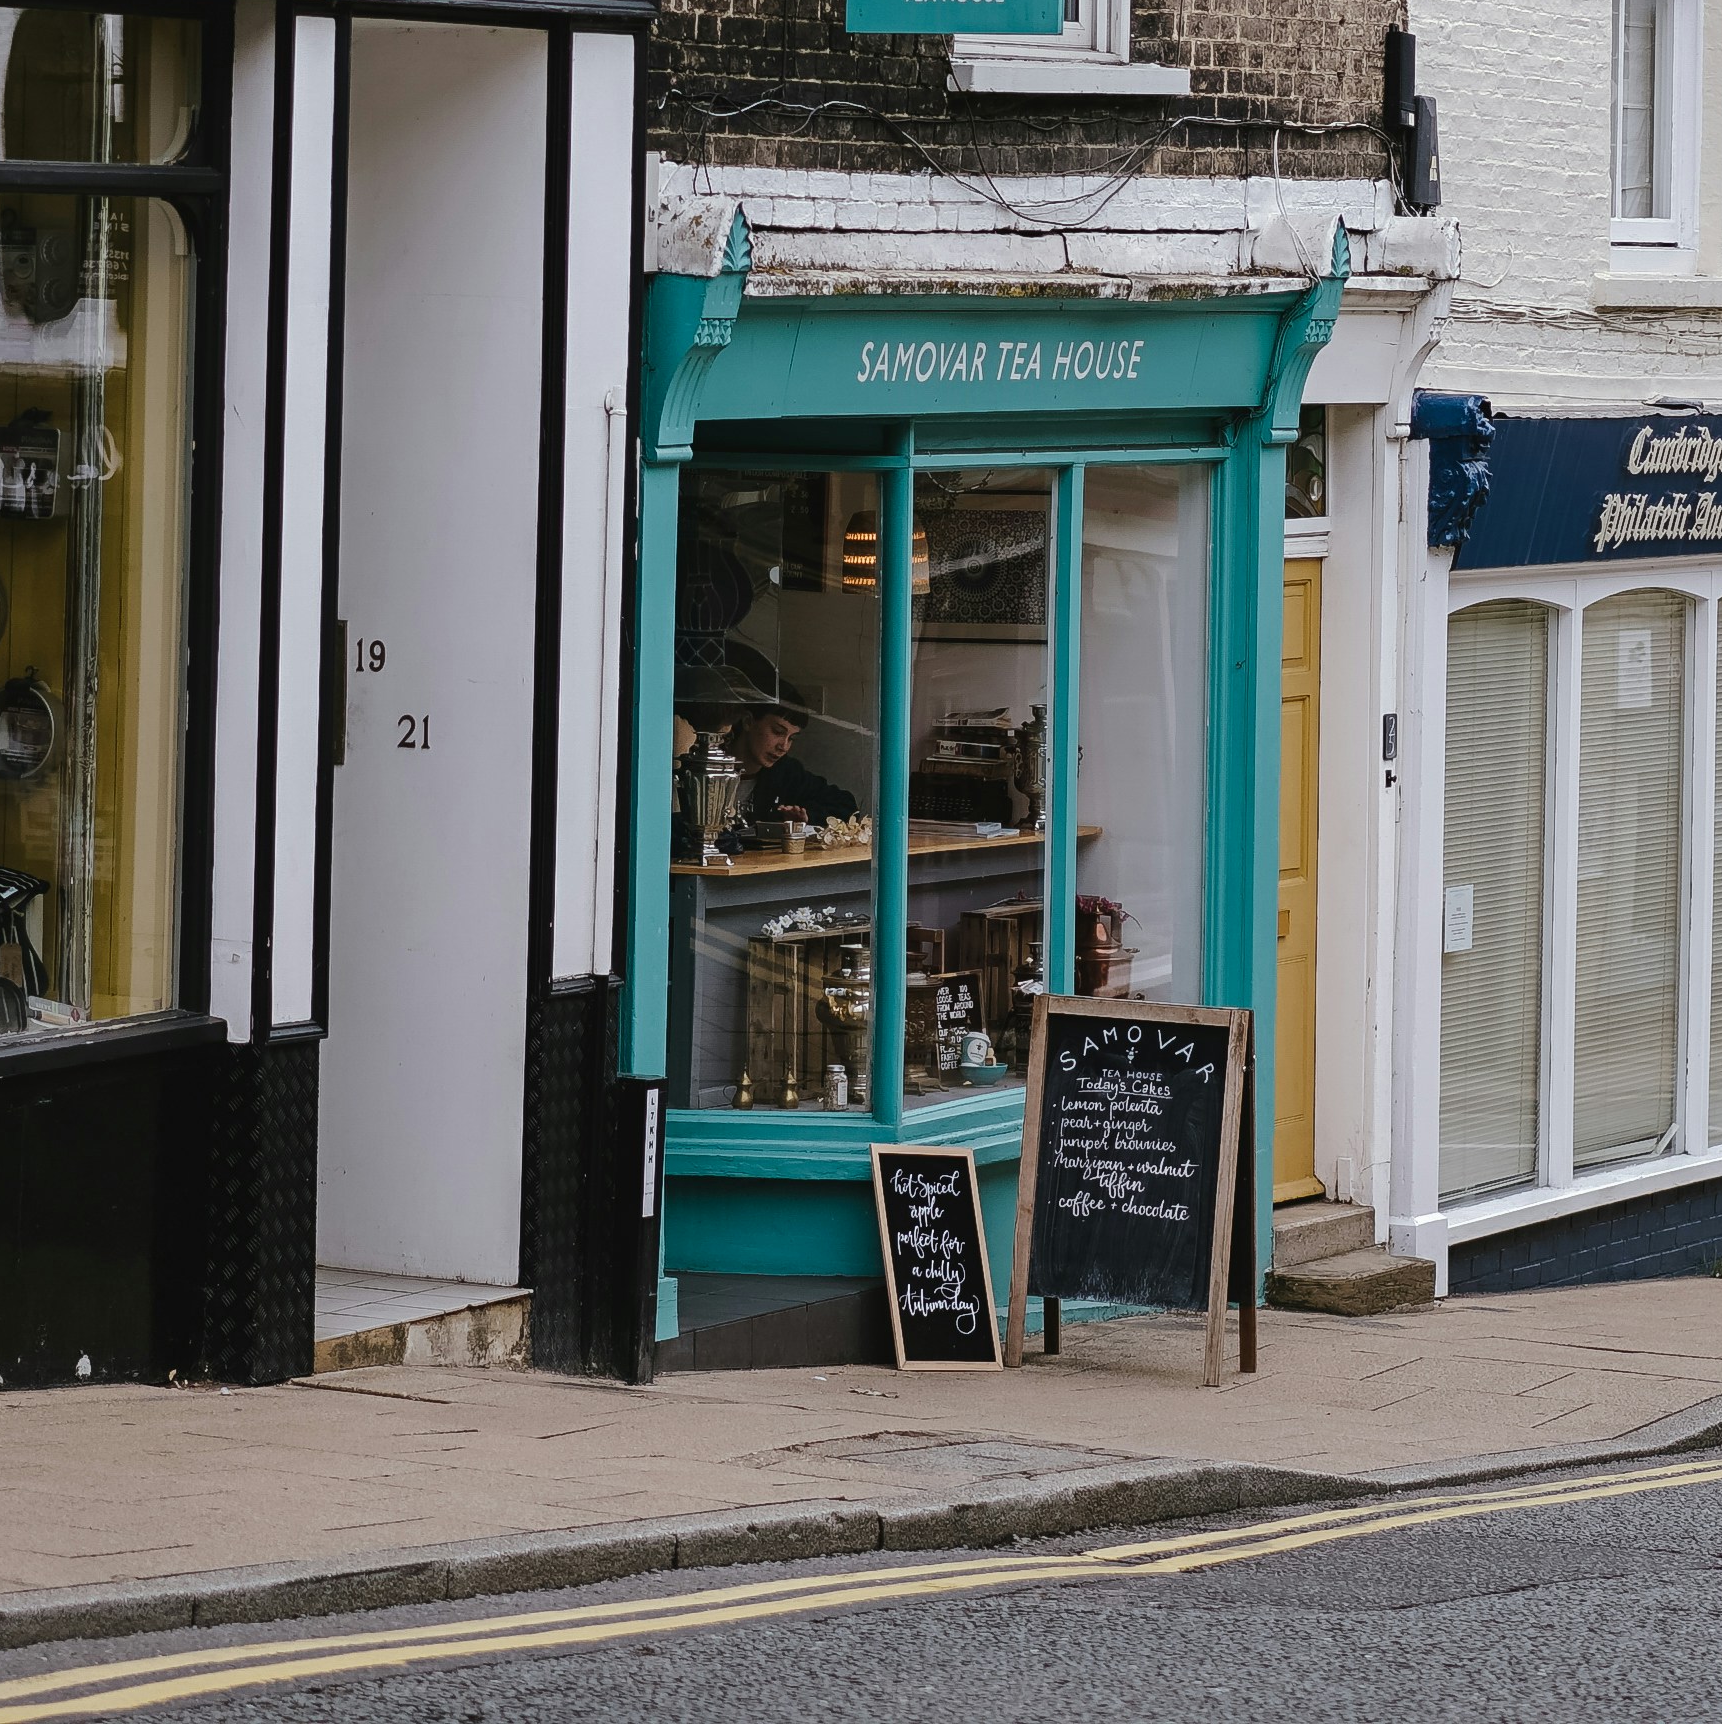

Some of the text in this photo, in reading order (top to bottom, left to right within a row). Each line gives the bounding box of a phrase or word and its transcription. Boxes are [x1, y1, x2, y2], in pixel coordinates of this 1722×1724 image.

[857, 340, 1144, 382] SAMOVAR TEA HOUSE
[1593, 493, 1691, 552] Philatelic
[356, 638, 386, 673] 19
[397, 714, 430, 749] 21
[937, 993, 971, 1004] LOOSE TEAS
[937, 1001, 974, 1012] FROM AROUND
[936, 1010, 966, 1020] THE WORLD
[1060, 1026, 1214, 1083] SAMOVAR
[1076, 1077, 1171, 1100] Today's Cakes
[1102, 1069, 1162, 1082] TEA HOUSE
[1062, 1095, 1163, 1120] lemon polenta
[1055, 1132, 1176, 1158] juniper brownies
[1137, 1157, 1199, 1177] walnut
[890, 1169, 918, 1198] hot
[1089, 1171, 1145, 1198] tiffin
[909, 1196, 944, 1227] apple
[1059, 1190, 1106, 1216] coffee
[1122, 1195, 1189, 1220] chocolate
[897, 1226, 965, 1259] perfect for
[912, 1260, 966, 1296] a chilly
